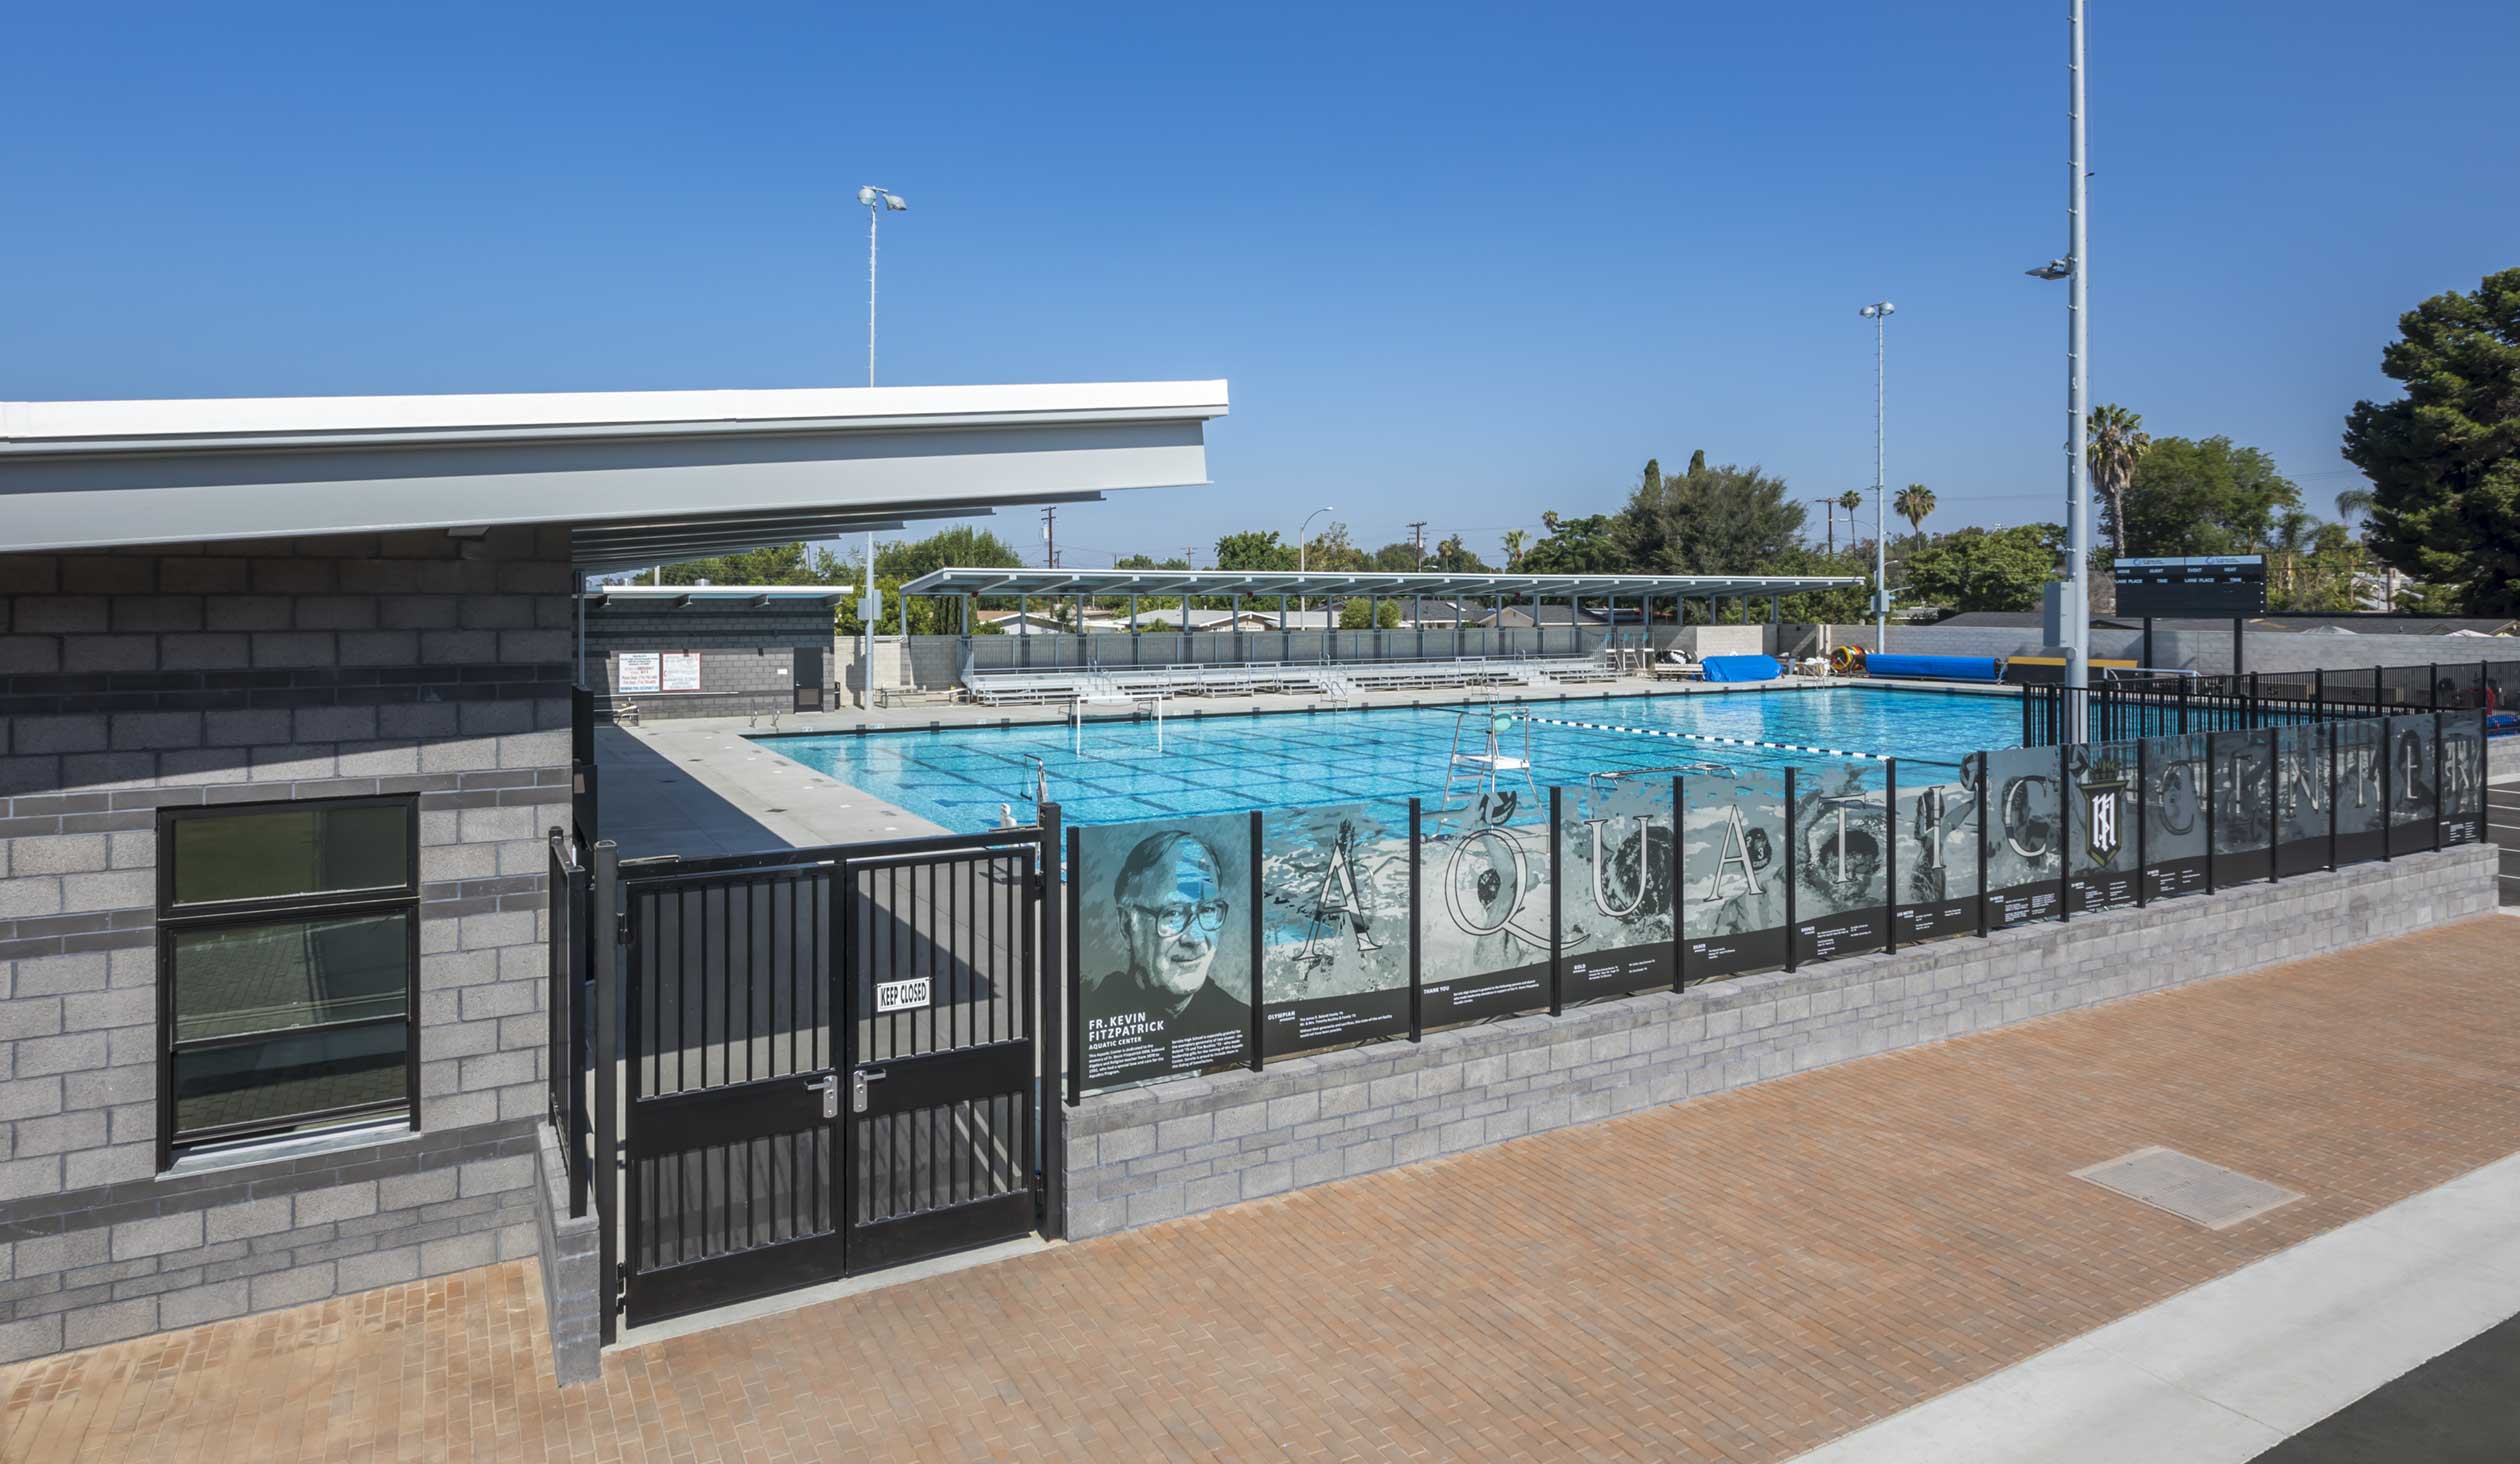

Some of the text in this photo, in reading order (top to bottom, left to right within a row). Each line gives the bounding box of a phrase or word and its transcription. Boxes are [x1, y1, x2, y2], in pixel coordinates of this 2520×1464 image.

[881, 982, 926, 1007] KEEP CLOSED
[1089, 1012, 1146, 1030] FR. KEVIN
[1089, 1020, 1164, 1041] FITZPATRICK
[1089, 1036, 1141, 1050] AQUATIC CENTER
